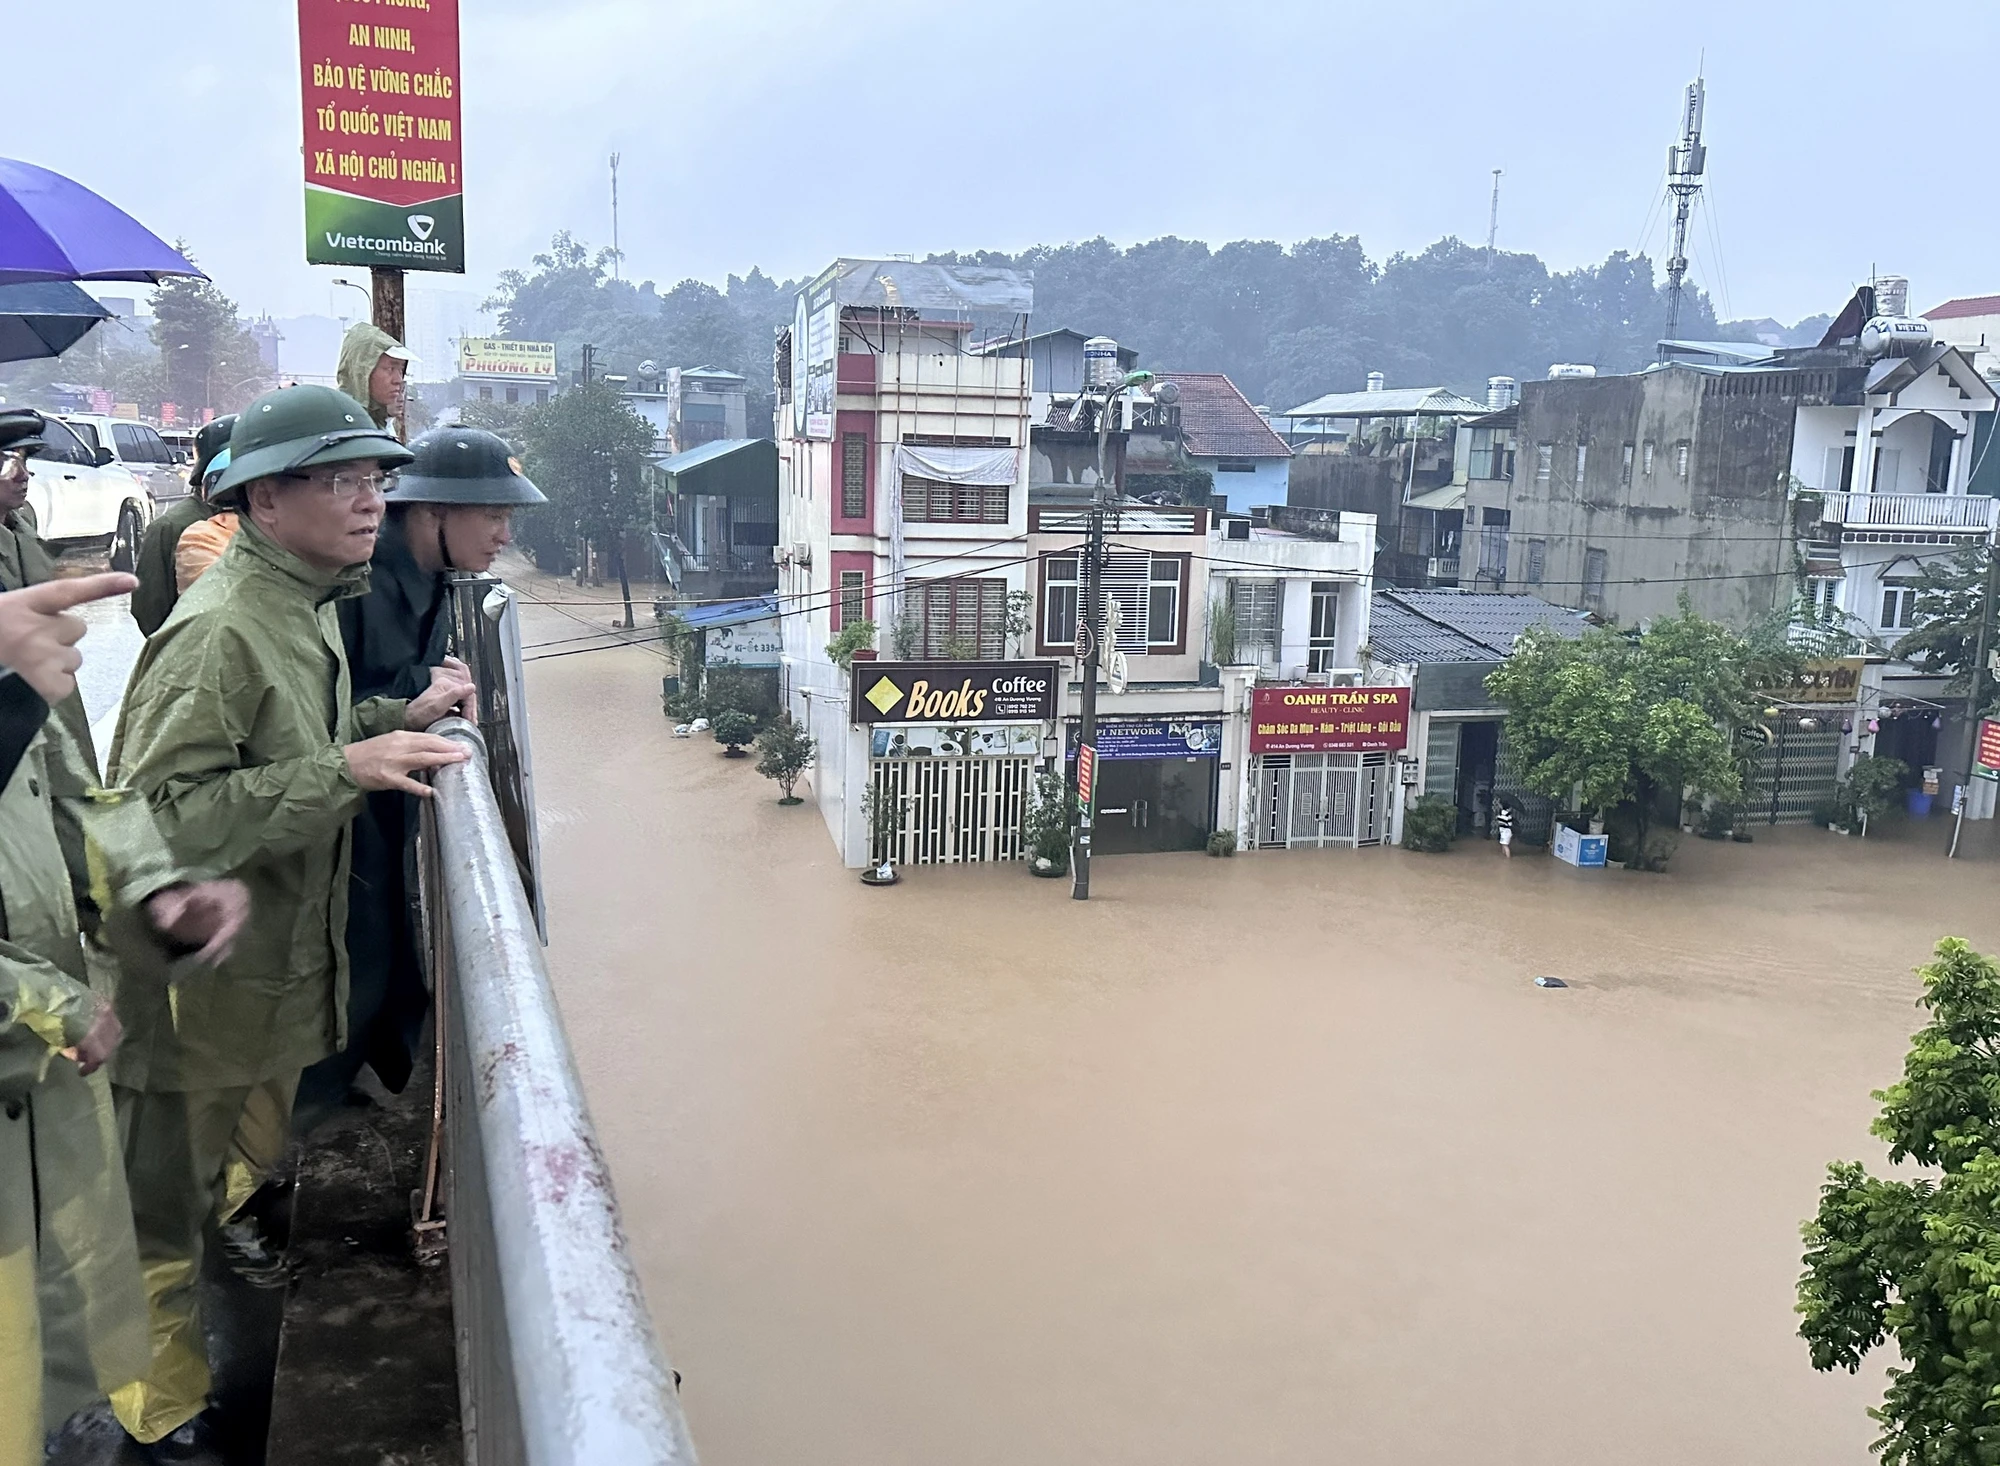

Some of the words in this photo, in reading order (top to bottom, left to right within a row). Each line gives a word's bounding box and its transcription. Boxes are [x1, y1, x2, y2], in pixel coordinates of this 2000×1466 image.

[349, 23, 370, 46] AN
[374, 26, 415, 54] NINH,
[312, 57, 344, 89] BẢO
[348, 63, 366, 95] VỆ
[370, 66, 410, 95] VỮNG
[413, 67, 453, 99] CHẮC
[317, 100, 336, 132] TỔ
[340, 105, 379, 136] QUỐC
[383, 111, 414, 143] VIỆT
[418, 118, 452, 141] NAM
[314, 148, 335, 175] XÃ
[339, 151, 364, 182] HỘI
[368, 150, 397, 180] CHỦ
[401, 156, 447, 184] NGHĨA
[450, 163, 456, 184] !
[325, 231, 446, 255] Vietcombank
[484, 342, 496, 350] GAS
[502, 342, 518, 352] THIẾT
[519, 344, 525, 353] BỊ
[527, 343, 540, 352] NHÀ
[541, 343, 553, 353] BẾP
[465, 358, 529, 373] PHƯƠNG
[992, 676, 1047, 693] Coffee
[904, 678, 988, 719] Books
[1283, 694, 1327, 706] OANH
[1372, 693, 1398, 704] SPA
[1109, 727, 1163, 736] NETWORK
[1258, 723, 1276, 735] Chăm
[1277, 723, 1289, 734] Sóc
[1290, 723, 1299, 734] Da
[1341, 721, 1356, 735] Triệt
[1740, 727, 1765, 740] Coffee
